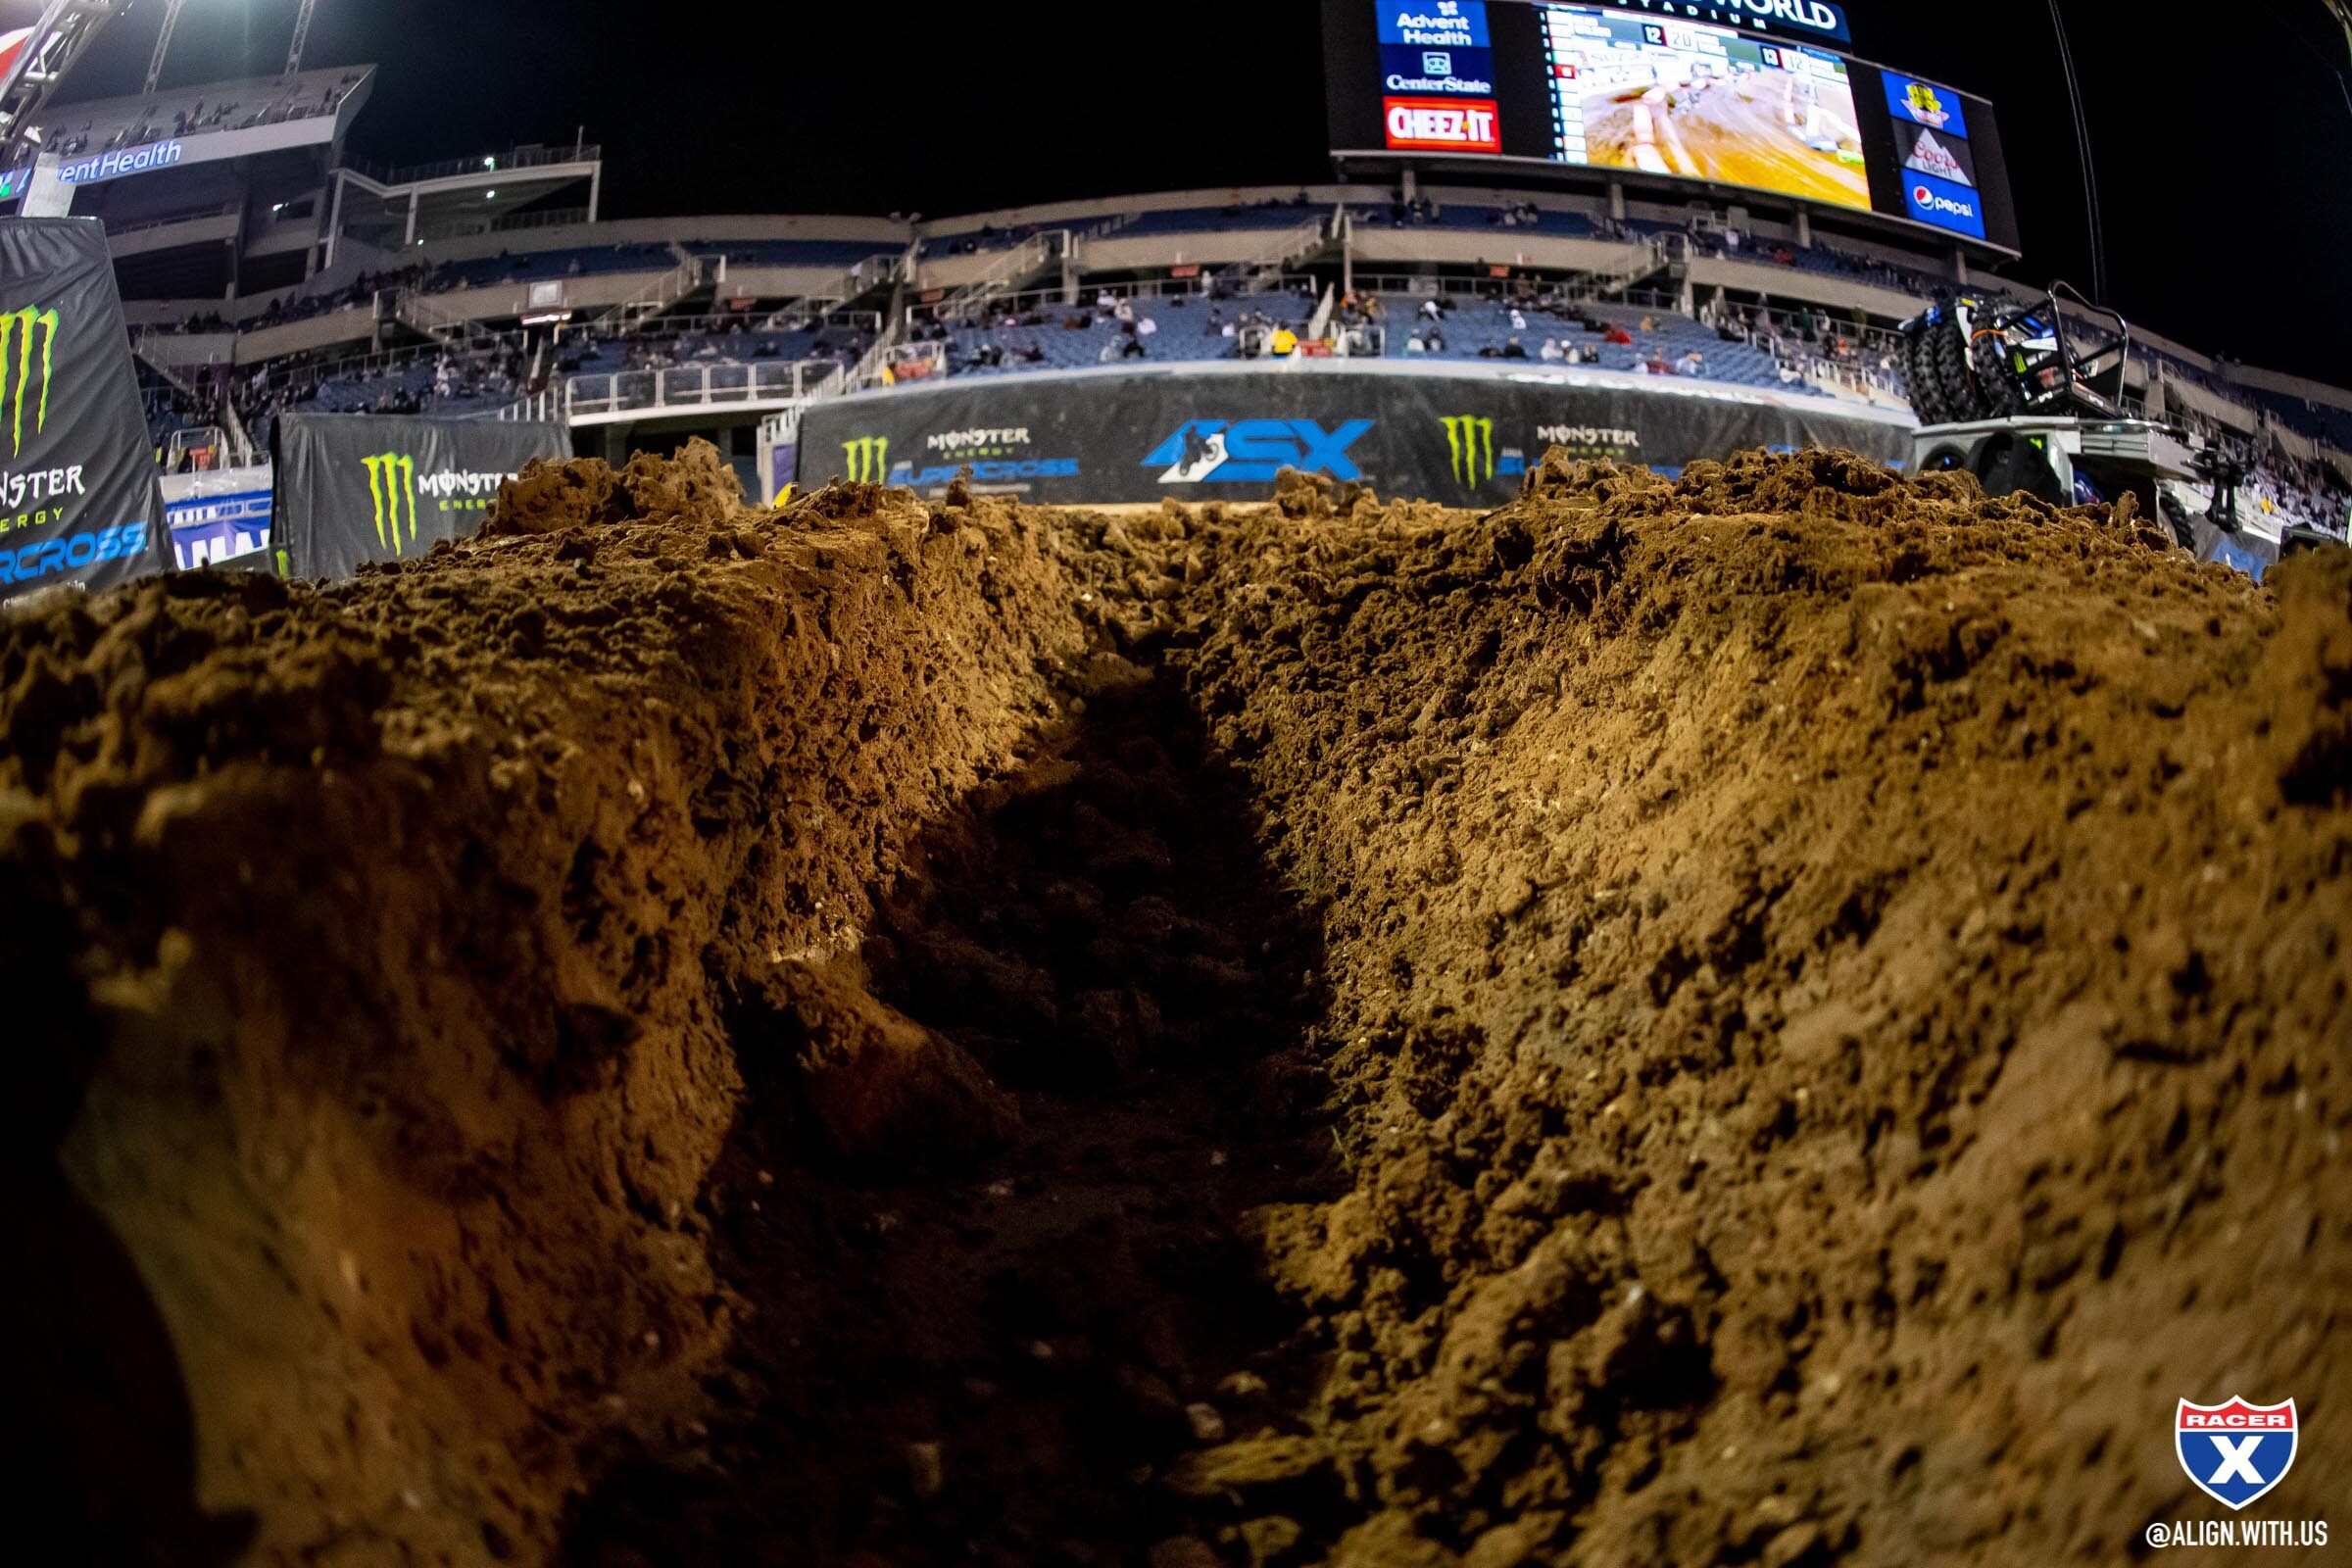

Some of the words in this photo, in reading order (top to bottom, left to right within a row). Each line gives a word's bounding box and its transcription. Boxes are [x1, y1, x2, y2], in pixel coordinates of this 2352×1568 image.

[1396, 13, 1470, 30] Advent
[1402, 28, 1472, 46] Health
[1644, 25, 1663, 44] 12
[1386, 74, 1492, 94] CenterState
[1935, 196, 1974, 219] pepsi
[927, 427, 1031, 451] MONSTER
[1537, 424, 1640, 447] MONSTER
